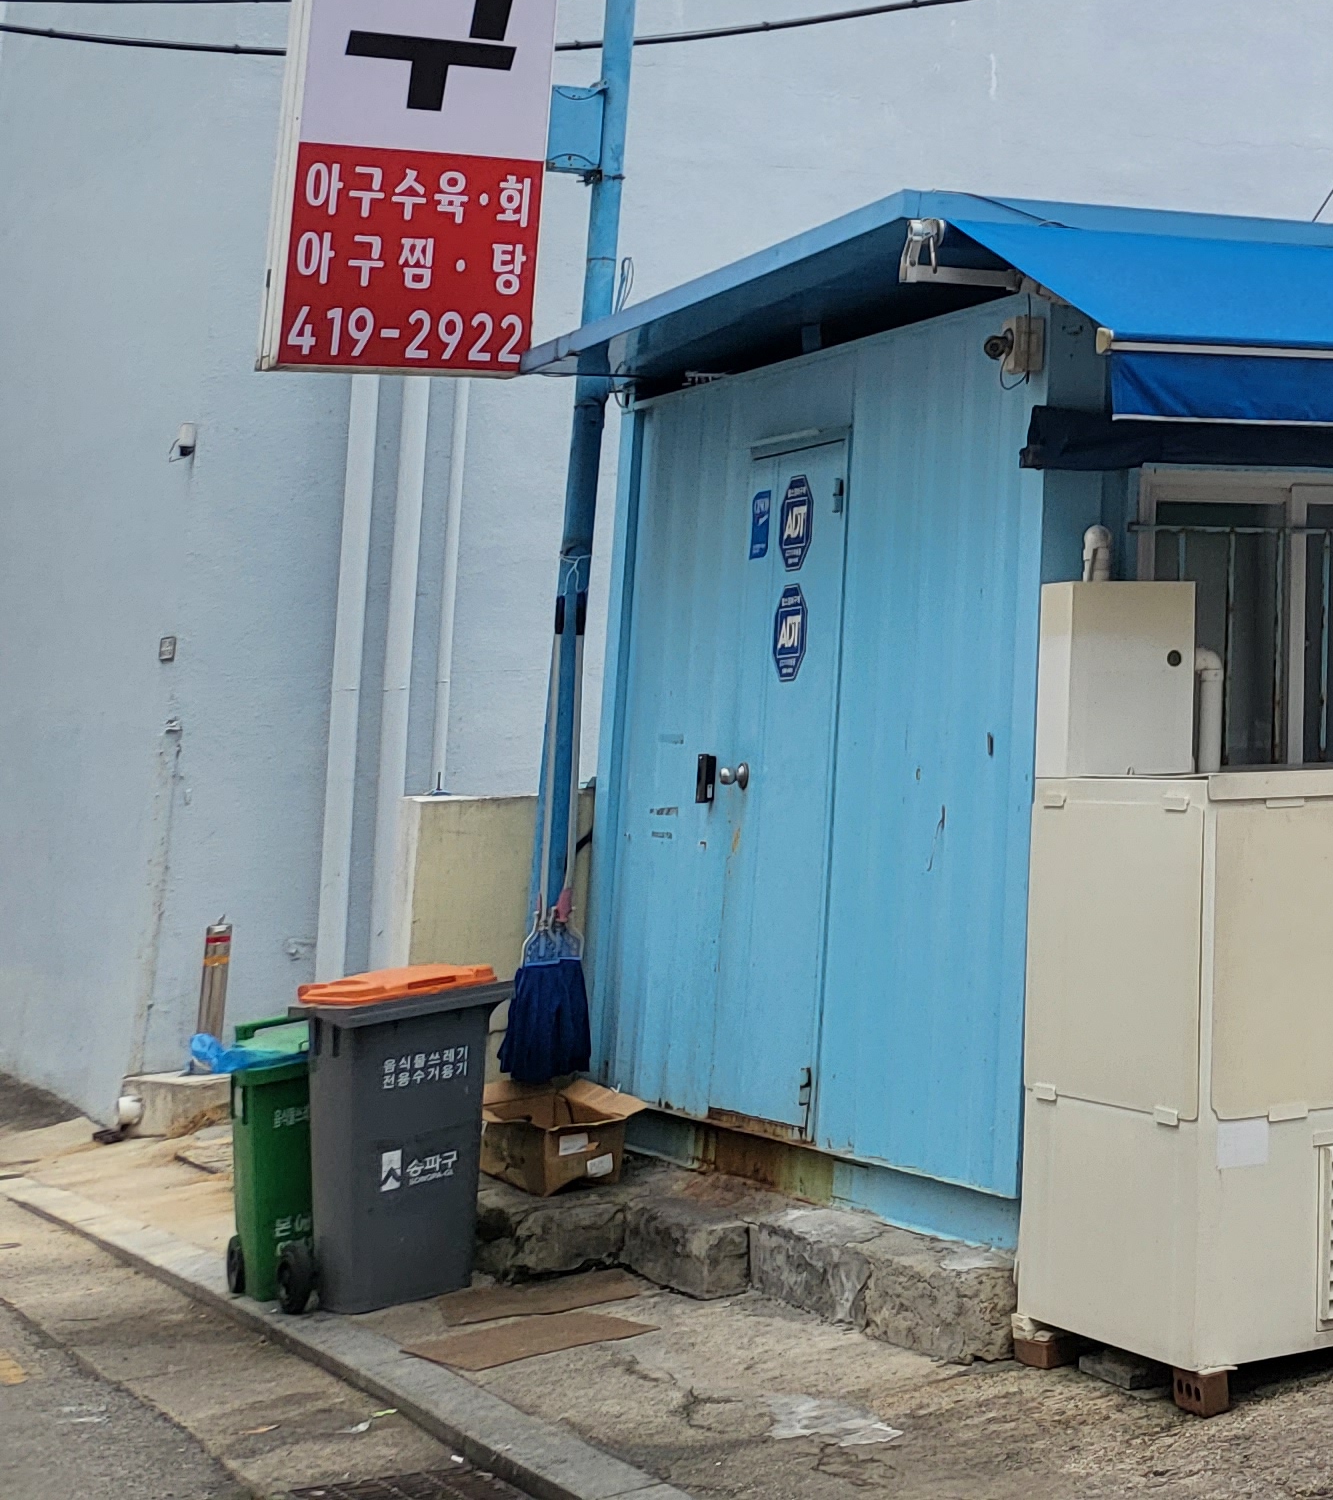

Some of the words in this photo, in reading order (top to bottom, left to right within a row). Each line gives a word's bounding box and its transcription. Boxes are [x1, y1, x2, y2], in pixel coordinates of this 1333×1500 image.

[287, 305, 523, 363] 419-2922
[783, 505, 807, 540] ADT
[777, 615, 801, 649] ADT
[383, 1046, 468, 1074] 음식물쓰레기
[383, 1061, 468, 1089] 전용수거용기
[406, 1150, 458, 1176] 송파구
